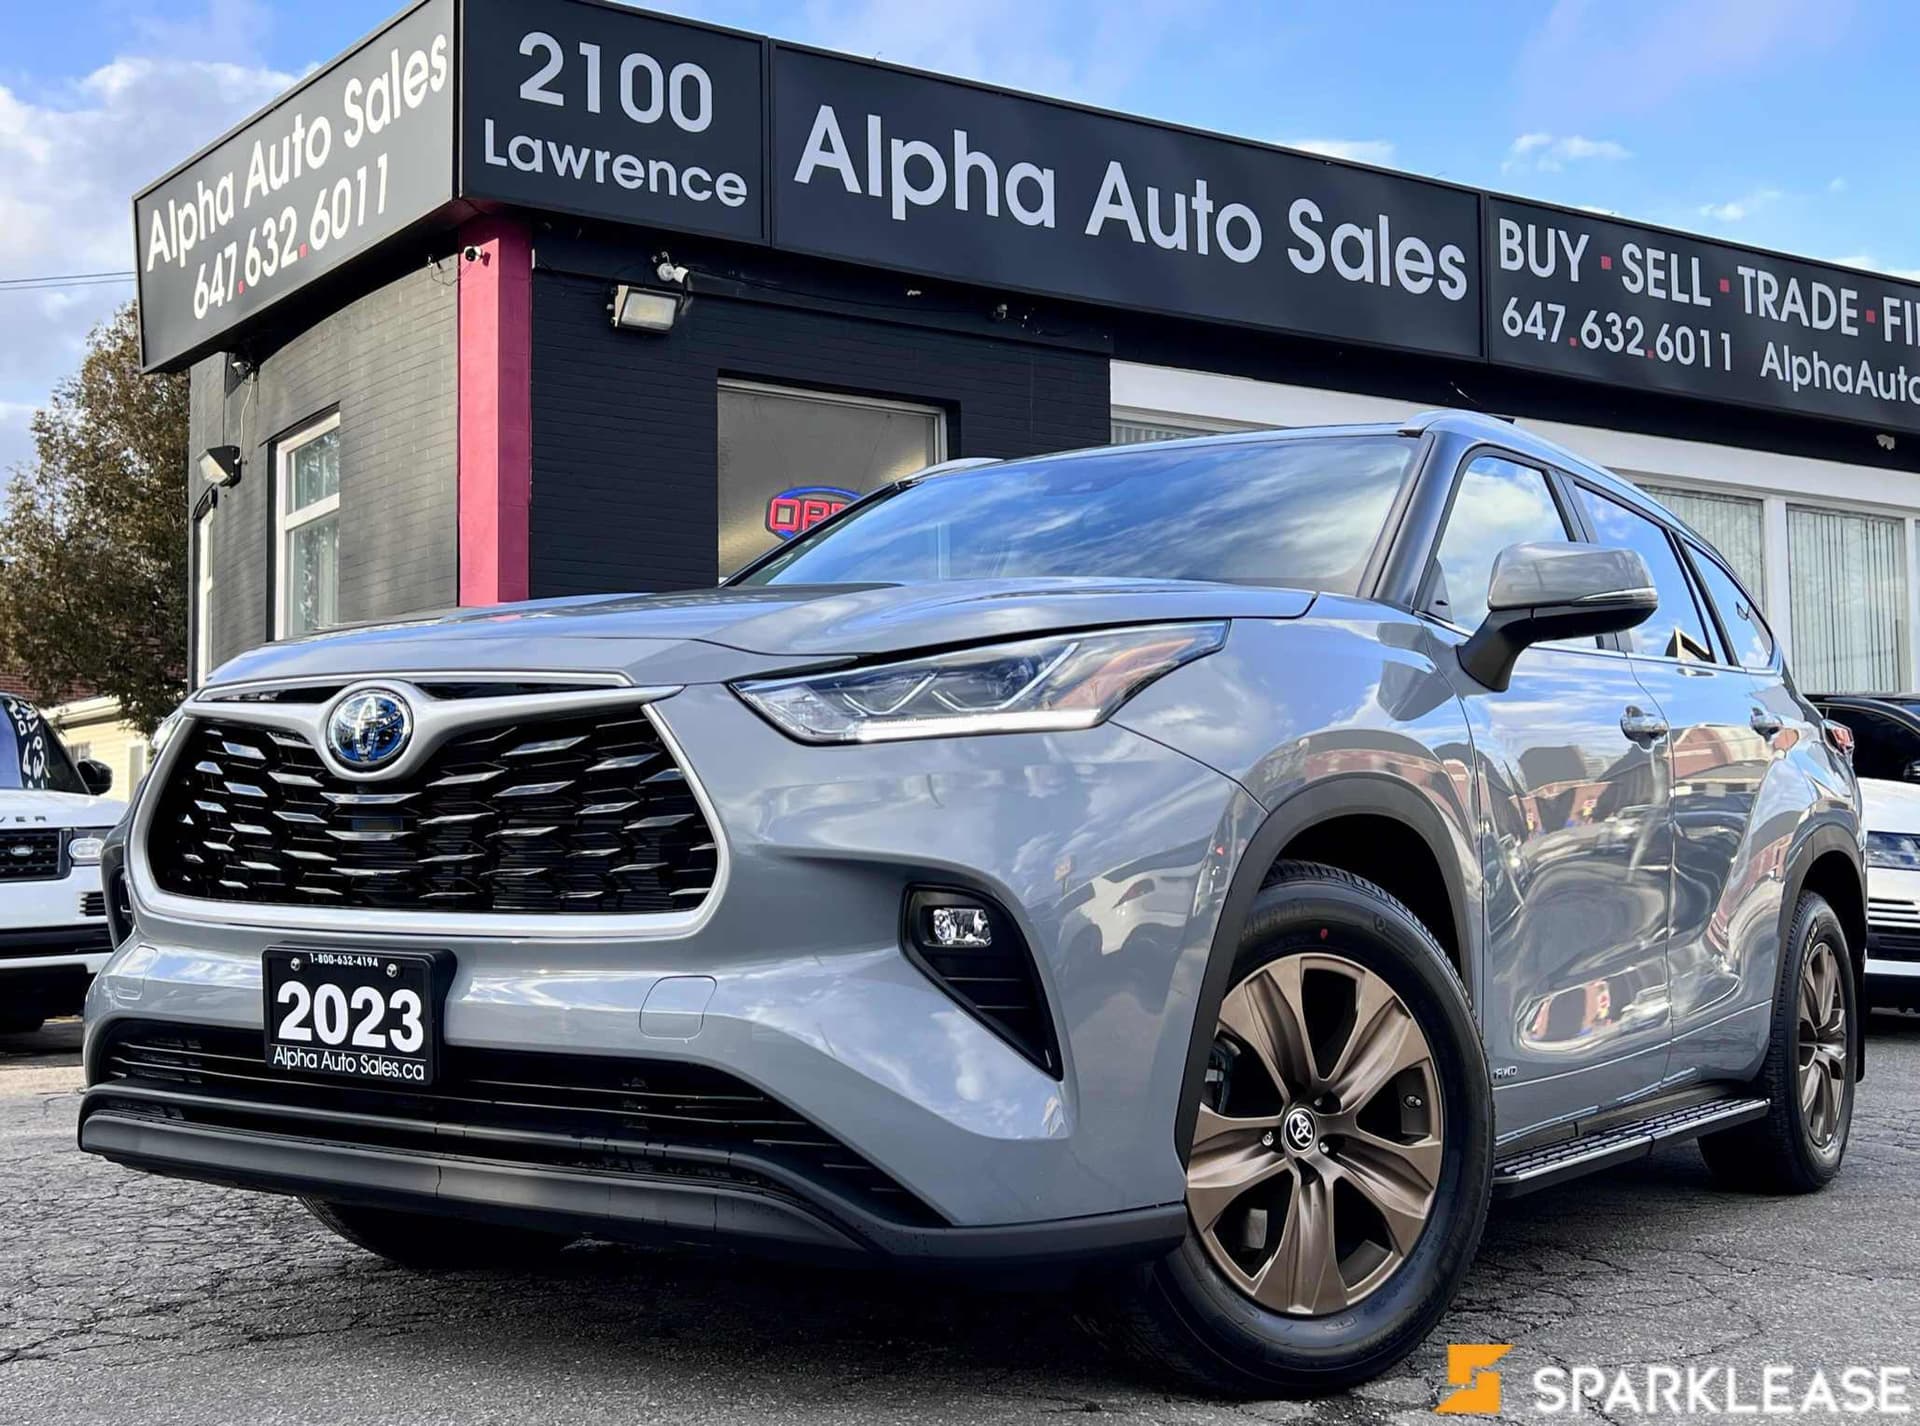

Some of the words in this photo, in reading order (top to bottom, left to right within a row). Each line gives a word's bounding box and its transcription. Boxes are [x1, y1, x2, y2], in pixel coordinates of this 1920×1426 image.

[519, 31, 713, 133] 2100
[147, 169, 234, 272] Alpha
[244, 112, 332, 209] Auto
[344, 33, 447, 148] Sales
[484, 118, 748, 208] Lawrence
[194, 153, 390, 320] 647.632.6011
[794, 104, 1056, 229] Alpha
[1085, 160, 1262, 264] Auto
[1287, 198, 1468, 301] Sales
[1499, 218, 1589, 282] BUY
[1621, 242, 1711, 308] SELL
[1737, 265, 1859, 336] TRADE
[1883, 296, 1920, 347] FI
[1502, 296, 1732, 371] 647.632.6011
[769, 498, 849, 532] OP
[309, 953, 379, 967] 1-800-632-4194
[277, 980, 424, 1053] 2023
[273, 1047, 317, 1070] Alpha
[321, 1051, 356, 1073] Auto
[360, 1054, 425, 1080] Sales.ca
